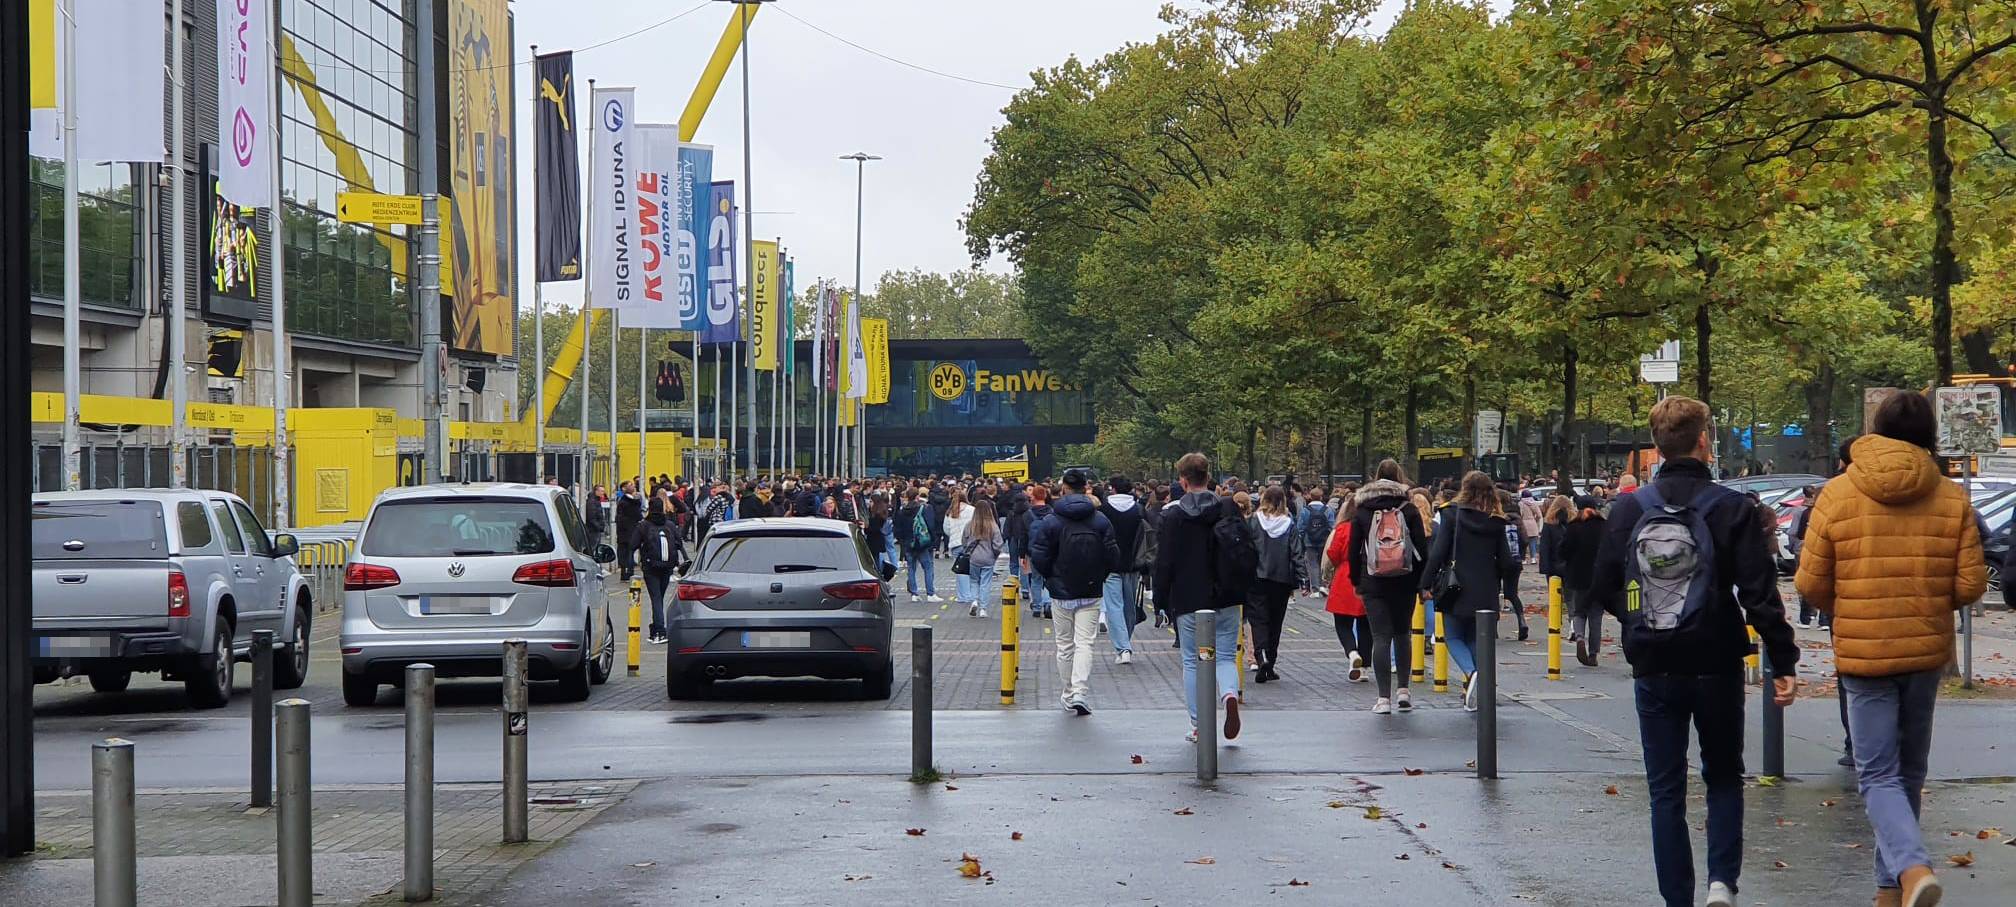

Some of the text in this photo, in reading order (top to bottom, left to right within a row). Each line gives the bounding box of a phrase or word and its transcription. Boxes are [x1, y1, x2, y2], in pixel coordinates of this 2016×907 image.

[613, 141, 630, 301] SIGNAL IDUNA
[661, 171, 671, 257] MOTOR OIL
[684, 159, 694, 222] SECURITY
[935, 367, 962, 388] BVB
[942, 388, 953, 396] 09
